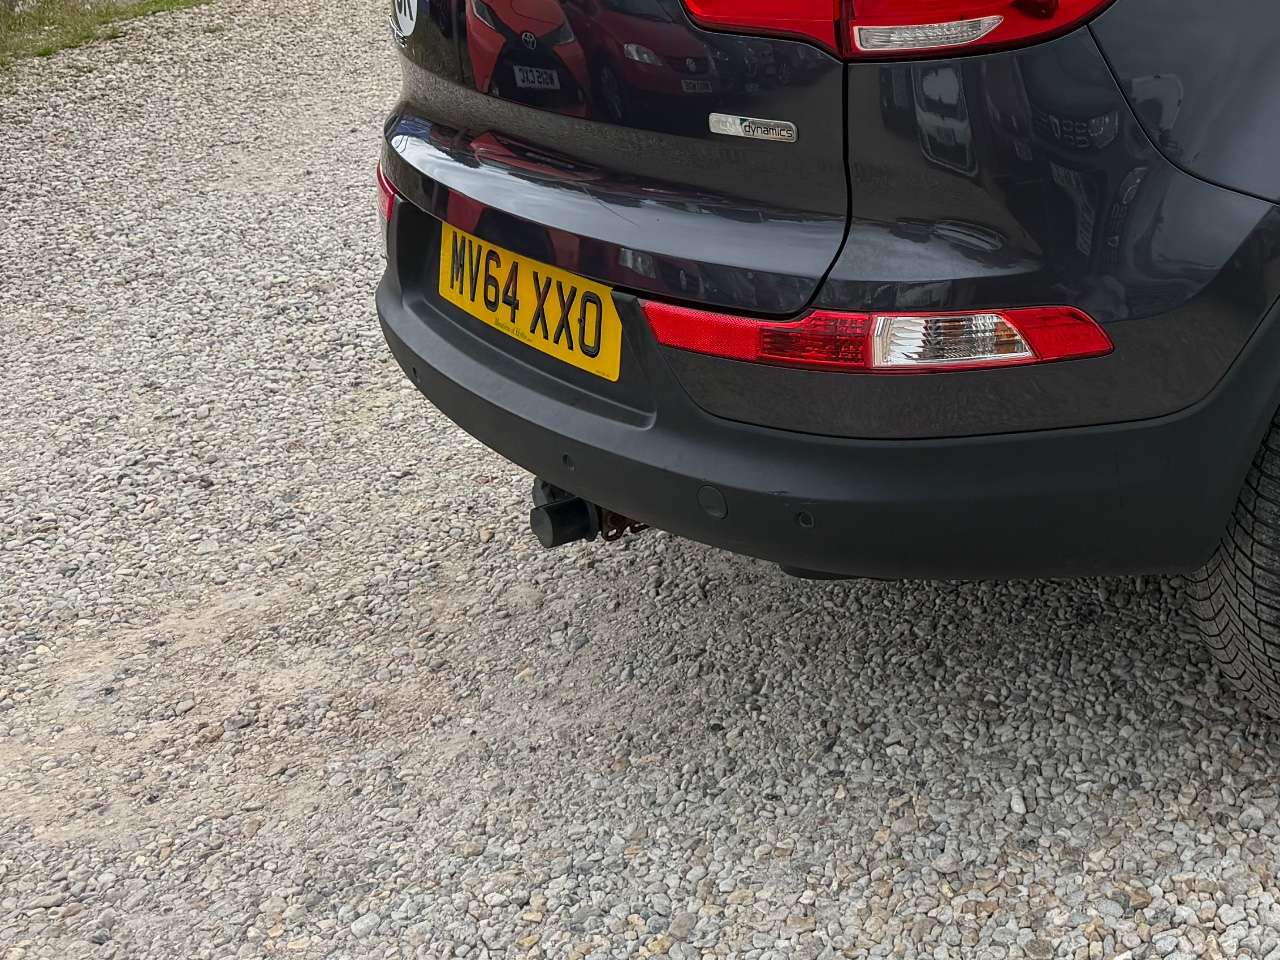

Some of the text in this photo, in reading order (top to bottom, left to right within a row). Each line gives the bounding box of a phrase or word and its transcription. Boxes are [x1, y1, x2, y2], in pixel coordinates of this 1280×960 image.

[743, 121, 793, 138] dynamics
[450, 230, 602, 359] MV64 XXO
